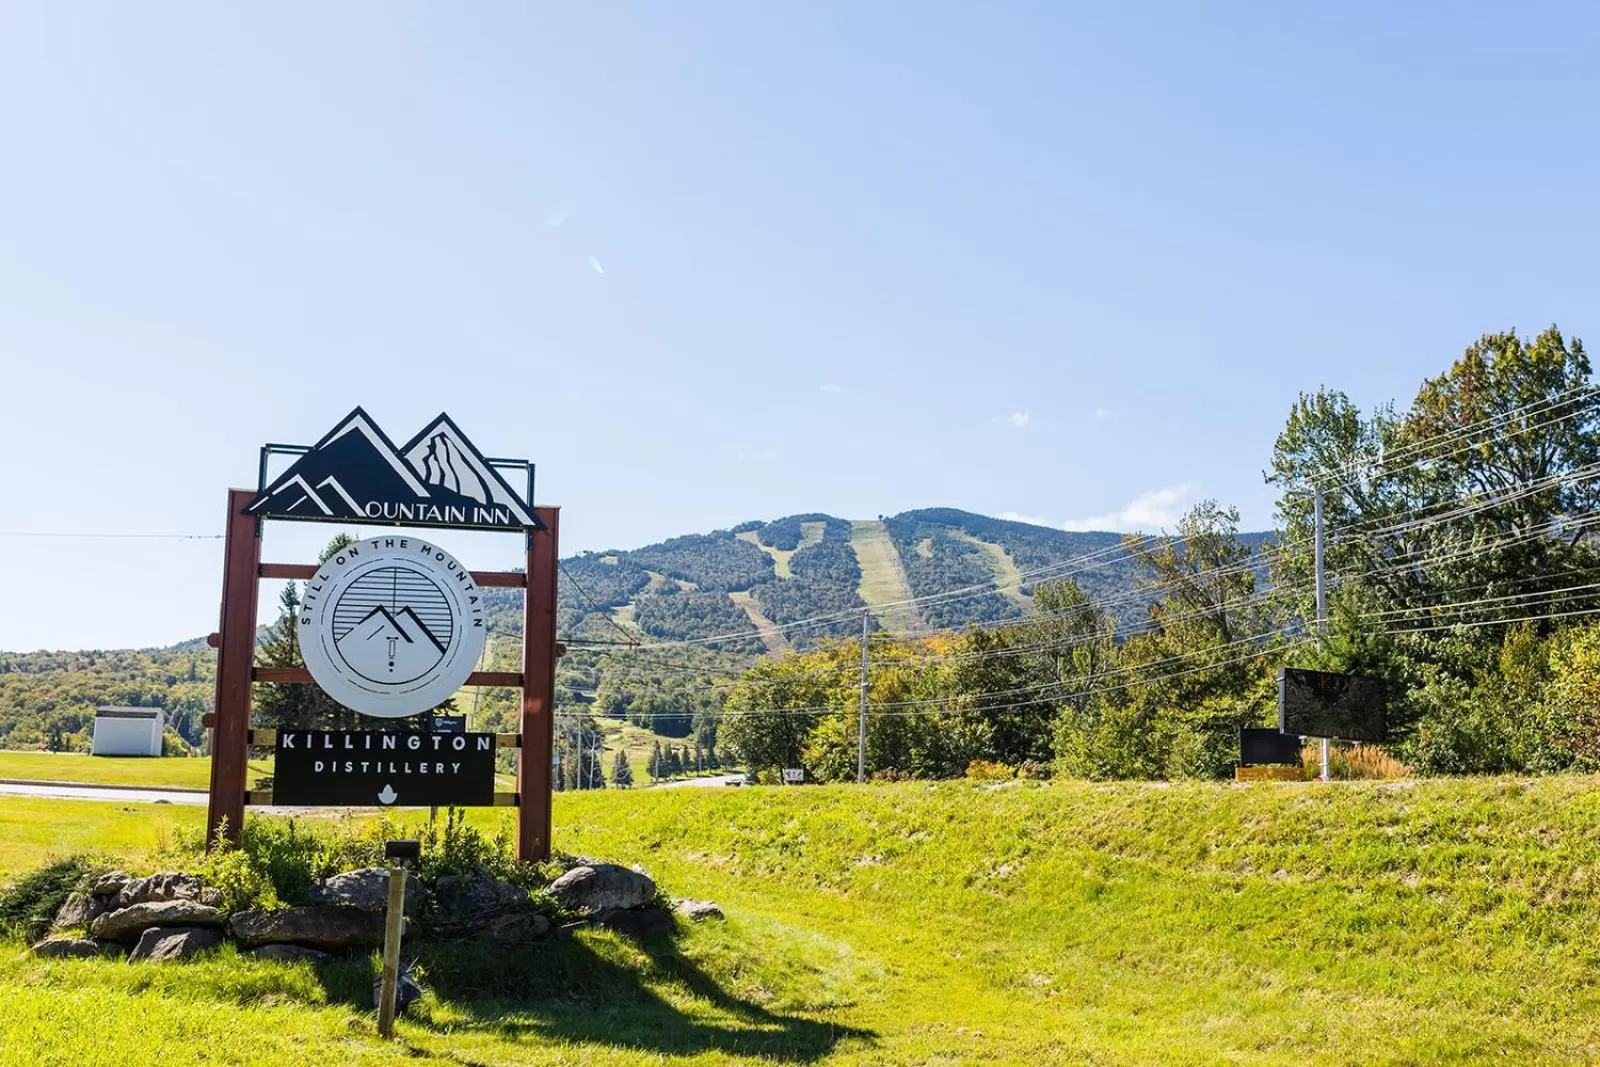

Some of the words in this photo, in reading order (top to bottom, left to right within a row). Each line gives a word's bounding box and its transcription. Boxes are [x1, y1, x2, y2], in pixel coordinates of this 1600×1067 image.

[473, 507, 511, 525] INN
[301, 573, 329, 626] STILL
[336, 547, 360, 566] ON
[371, 539, 408, 550] THE
[421, 546, 483, 628] MOUNTAIN
[282, 733, 491, 750] KILLINGTON
[314, 761, 462, 774] DISTILLERY
